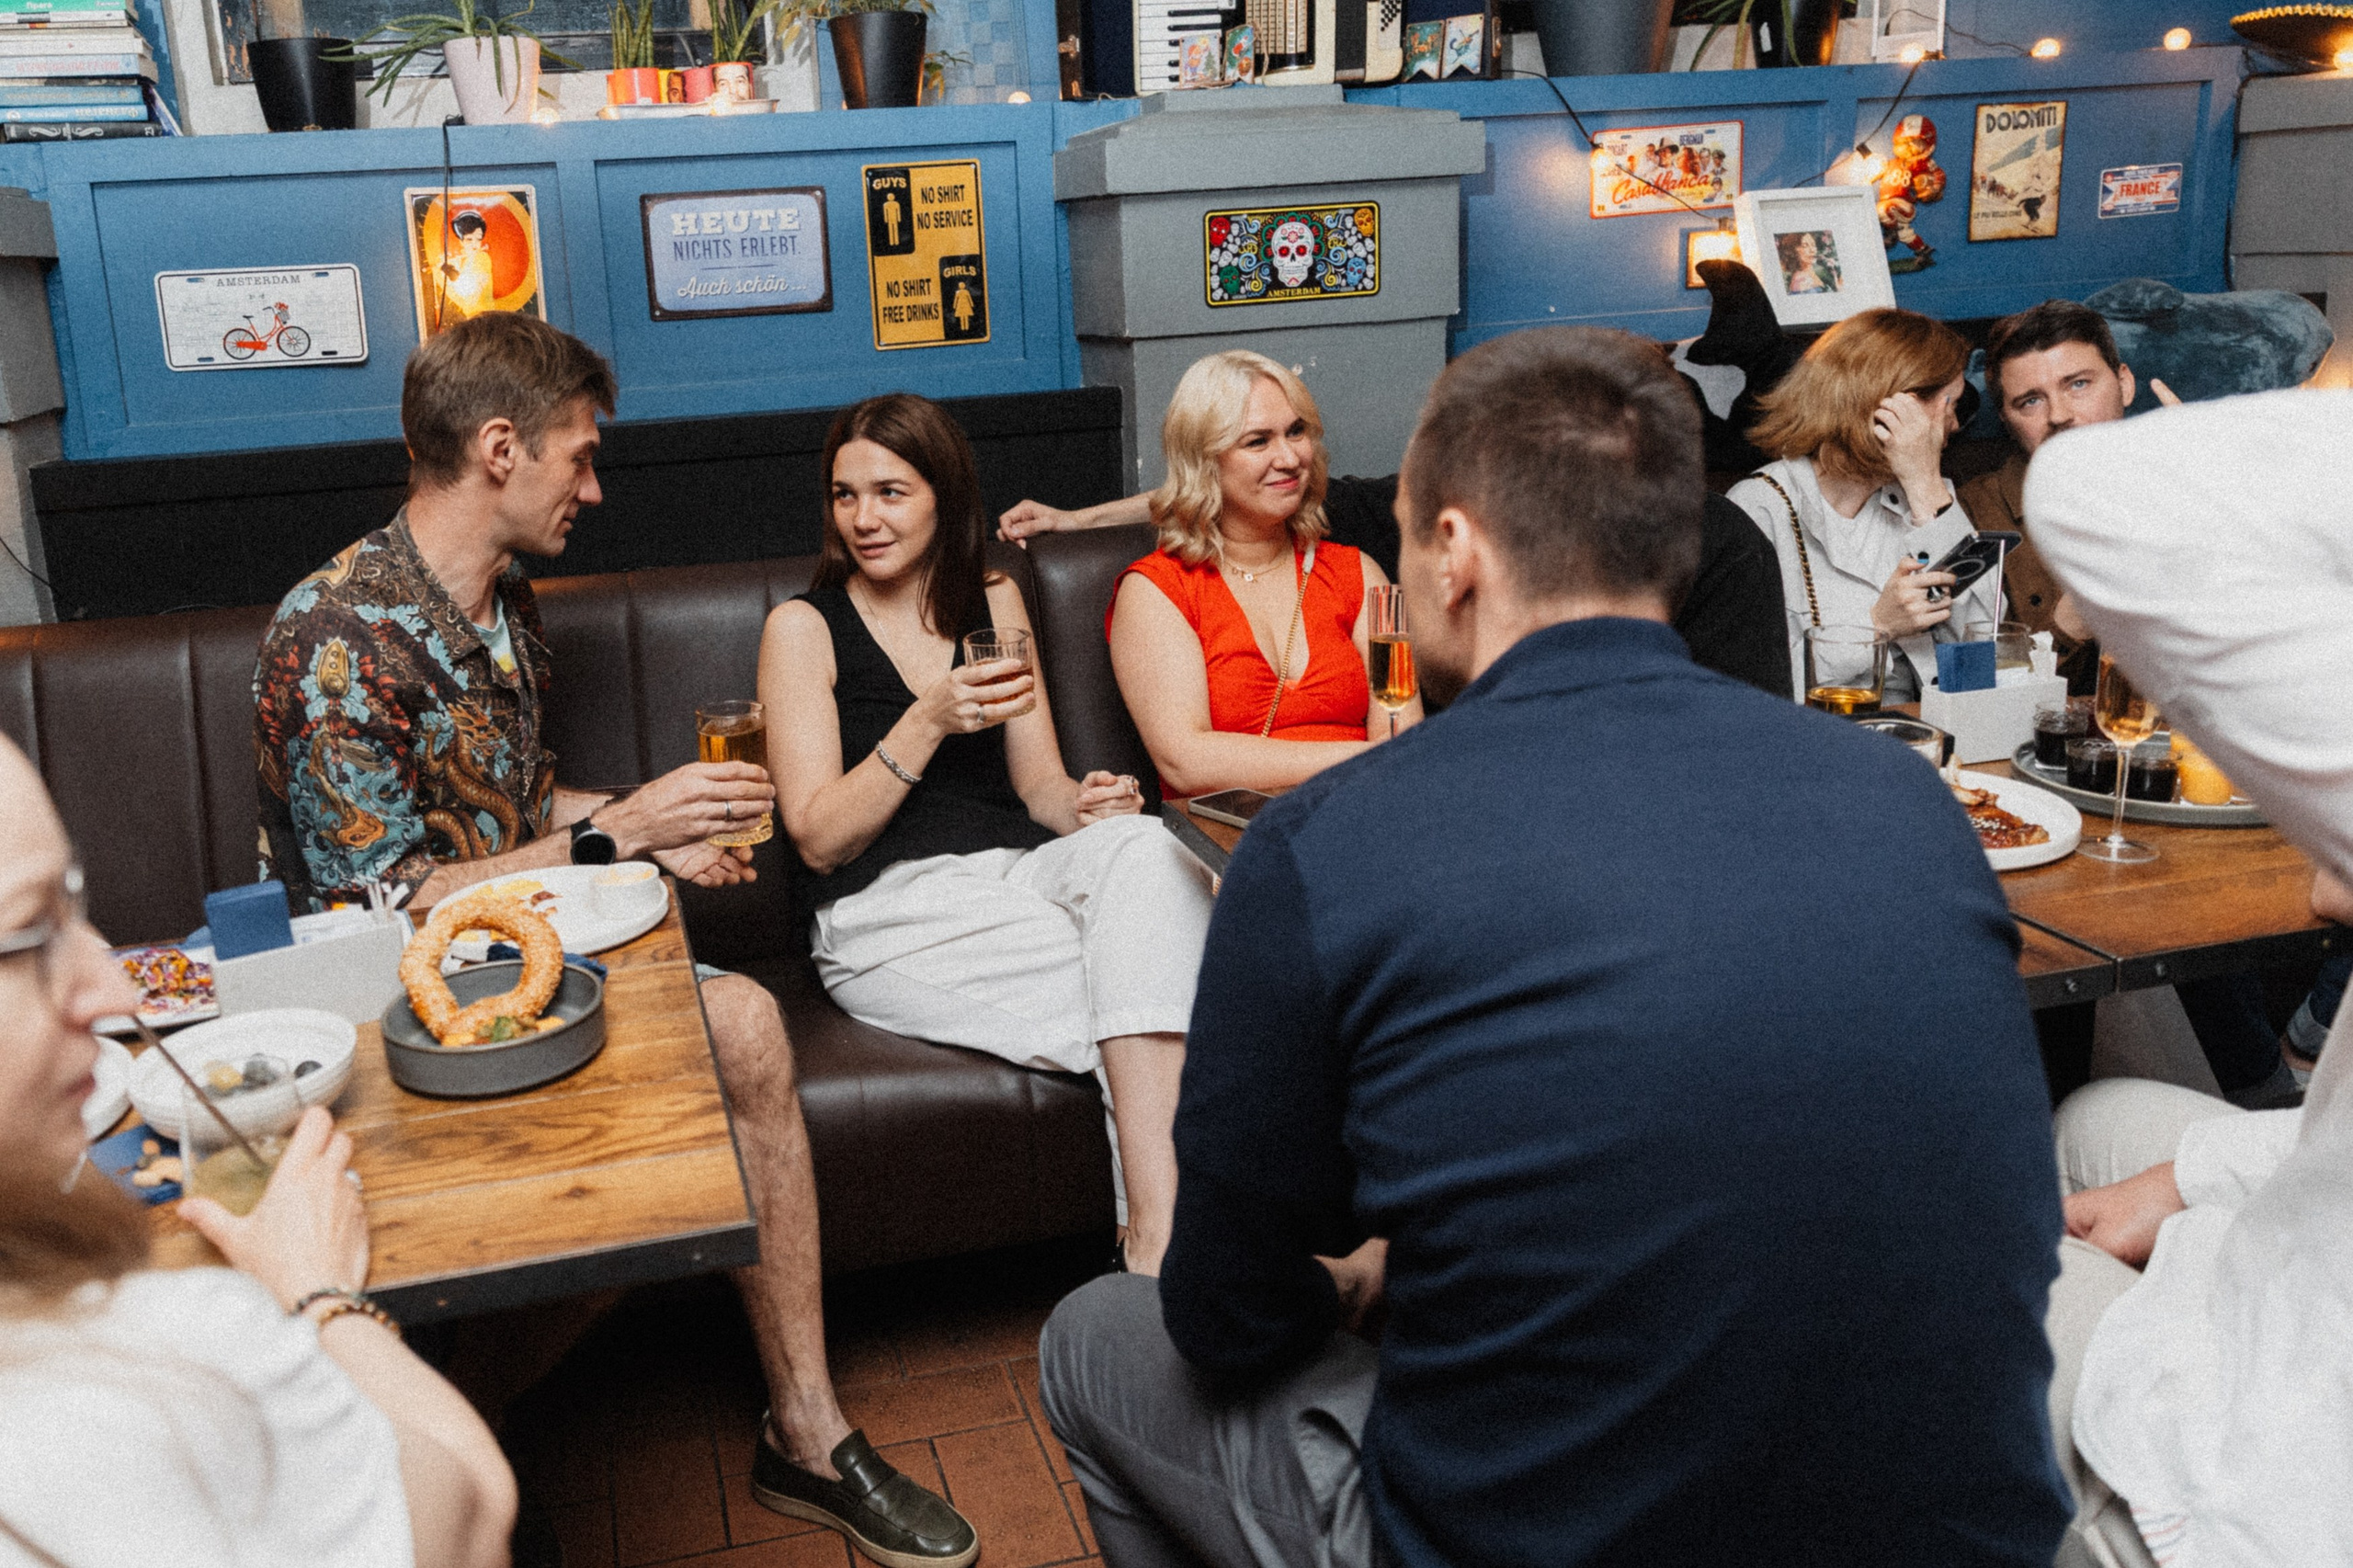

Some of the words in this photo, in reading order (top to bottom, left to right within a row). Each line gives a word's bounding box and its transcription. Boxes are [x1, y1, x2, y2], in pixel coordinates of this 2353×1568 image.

[1985, 107, 2057, 133] DOLOMITI
[872, 176, 907, 190] GUYS
[1612, 170, 1710, 205] Casablanca
[2120, 181, 2161, 197] FRANCE
[921, 187, 935, 204] NO
[938, 185, 965, 203] SHIRT
[670, 208, 801, 236] HEUTE
[917, 212, 931, 230] NO
[933, 210, 973, 229] SERVICE
[673, 239, 733, 261] NICHTS
[741, 235, 801, 258] ERLEBT.
[216, 275, 301, 287] AMSTERDAM
[943, 266, 977, 278] GIRLS
[677, 276, 733, 299] Auch
[735, 273, 789, 294] schön
[886, 280, 900, 299] NO
[903, 278, 931, 297] SHIRT
[1267, 287, 1321, 297] AMSTERDAM
[882, 305, 904, 324] FREE
[906, 302, 939, 322] DRINKS
